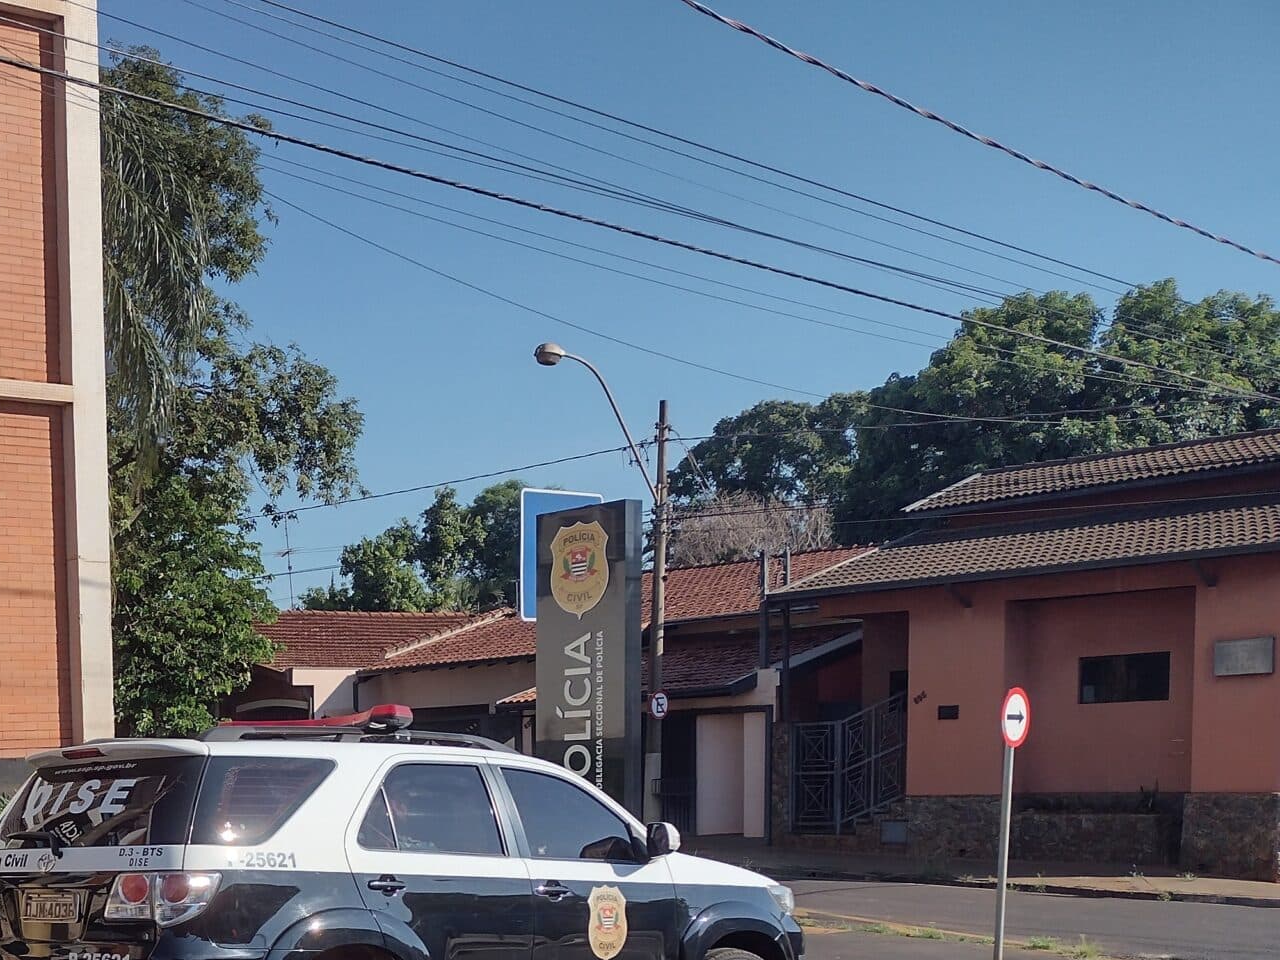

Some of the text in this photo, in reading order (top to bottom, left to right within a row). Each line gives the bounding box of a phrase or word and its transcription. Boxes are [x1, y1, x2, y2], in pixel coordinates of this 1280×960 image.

[563, 532, 595, 547] POLÍCIA
[567, 592, 592, 602] CIVIL
[596, 670, 603, 683] DE
[119, 848, 133, 857] D.3
[142, 847, 163, 857] BTS
[4, 854, 29, 867] Civil
[128, 858, 149, 867] DISE
[228, 851, 297, 868] -25621
